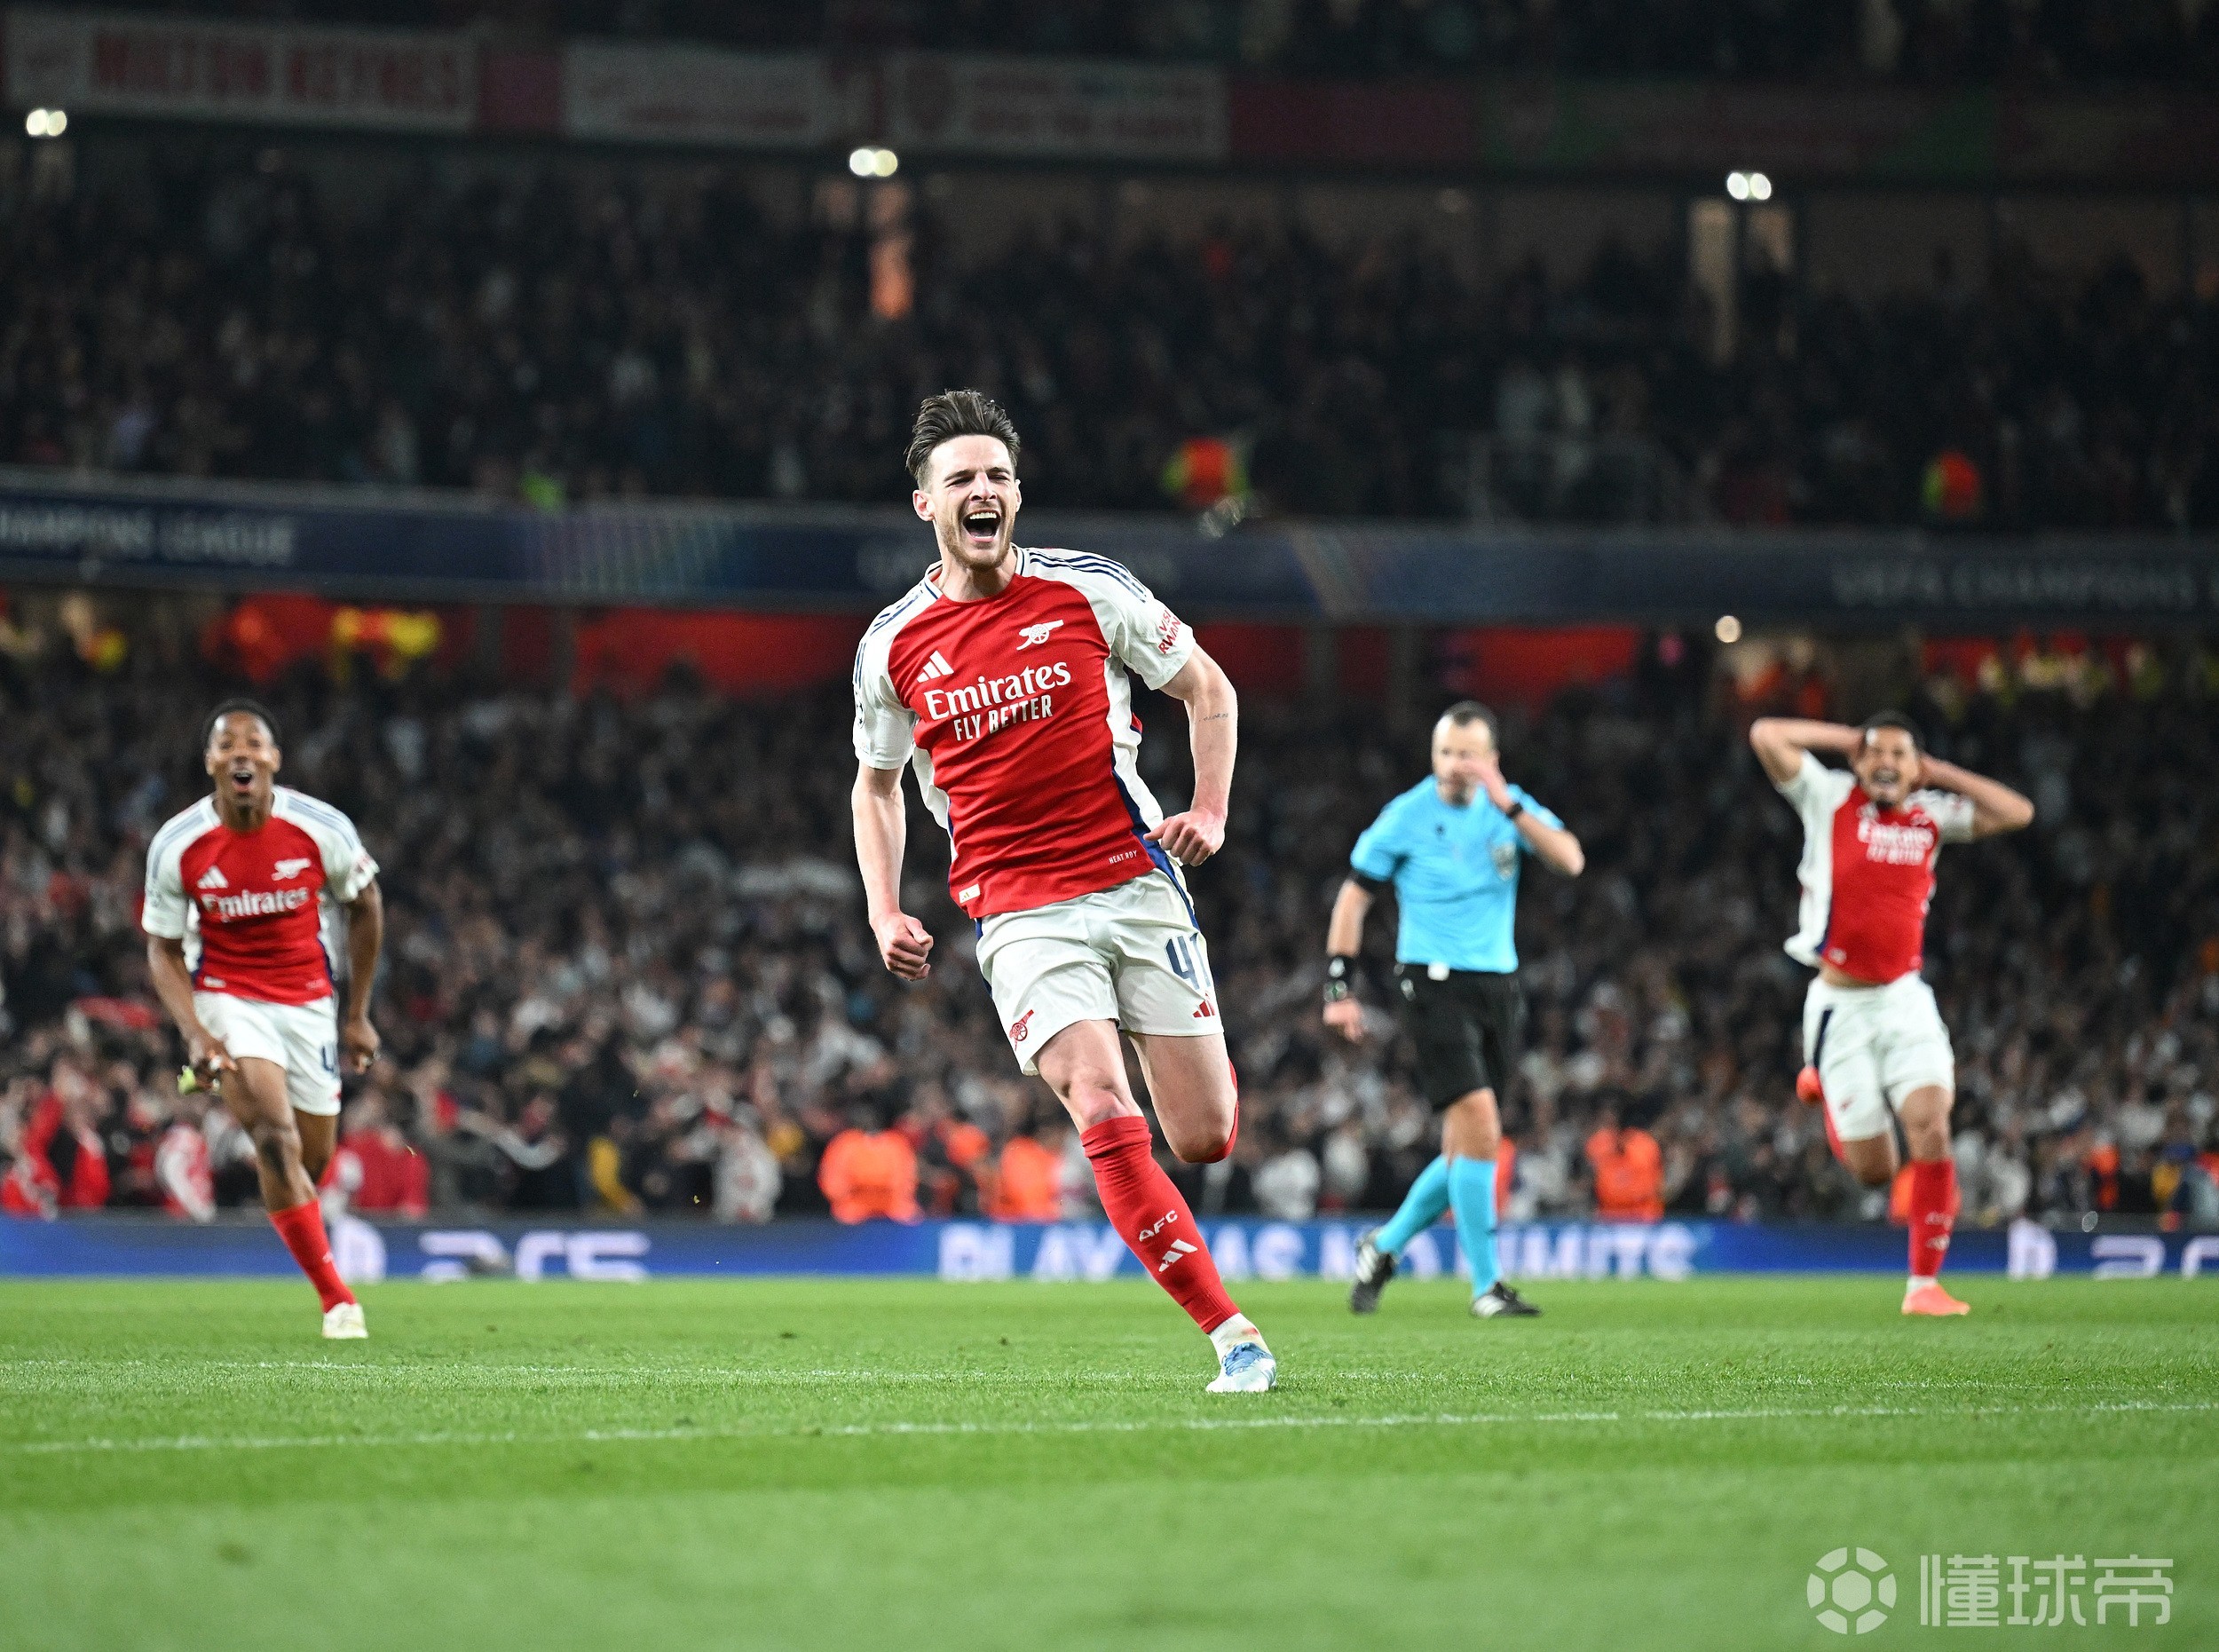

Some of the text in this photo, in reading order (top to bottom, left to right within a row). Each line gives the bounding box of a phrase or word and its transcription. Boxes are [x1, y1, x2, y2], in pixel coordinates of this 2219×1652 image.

[1158, 616, 1181, 654] RWAN
[923, 661, 1071, 721] Emirates
[953, 694, 1053, 741] FLY BETTER
[1139, 1210, 1178, 1242] AFC
